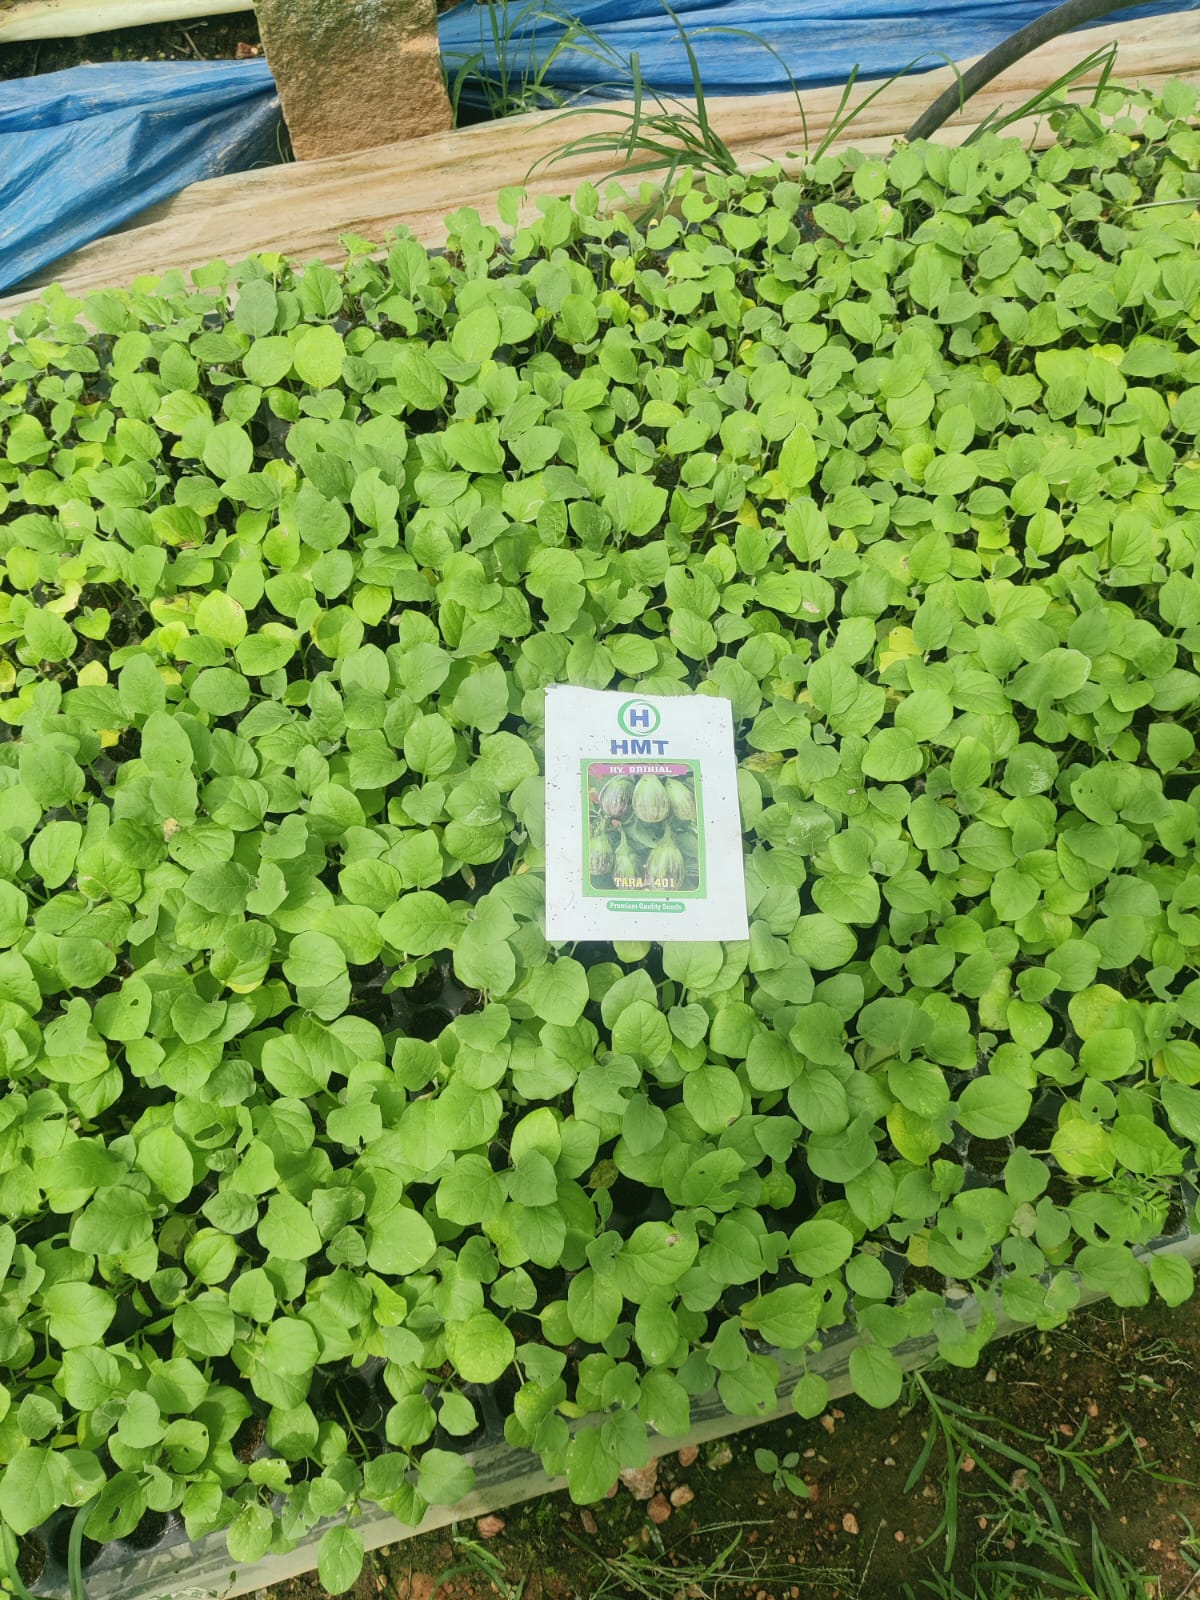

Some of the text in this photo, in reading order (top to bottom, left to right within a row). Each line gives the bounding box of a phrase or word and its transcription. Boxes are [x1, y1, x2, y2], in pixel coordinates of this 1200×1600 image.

[630, 709, 650, 727] H
[611, 739, 669, 755] HMT
[614, 877, 642, 888] TARA
[655, 877, 675, 888] 401
[639, 903, 661, 911] Quality
